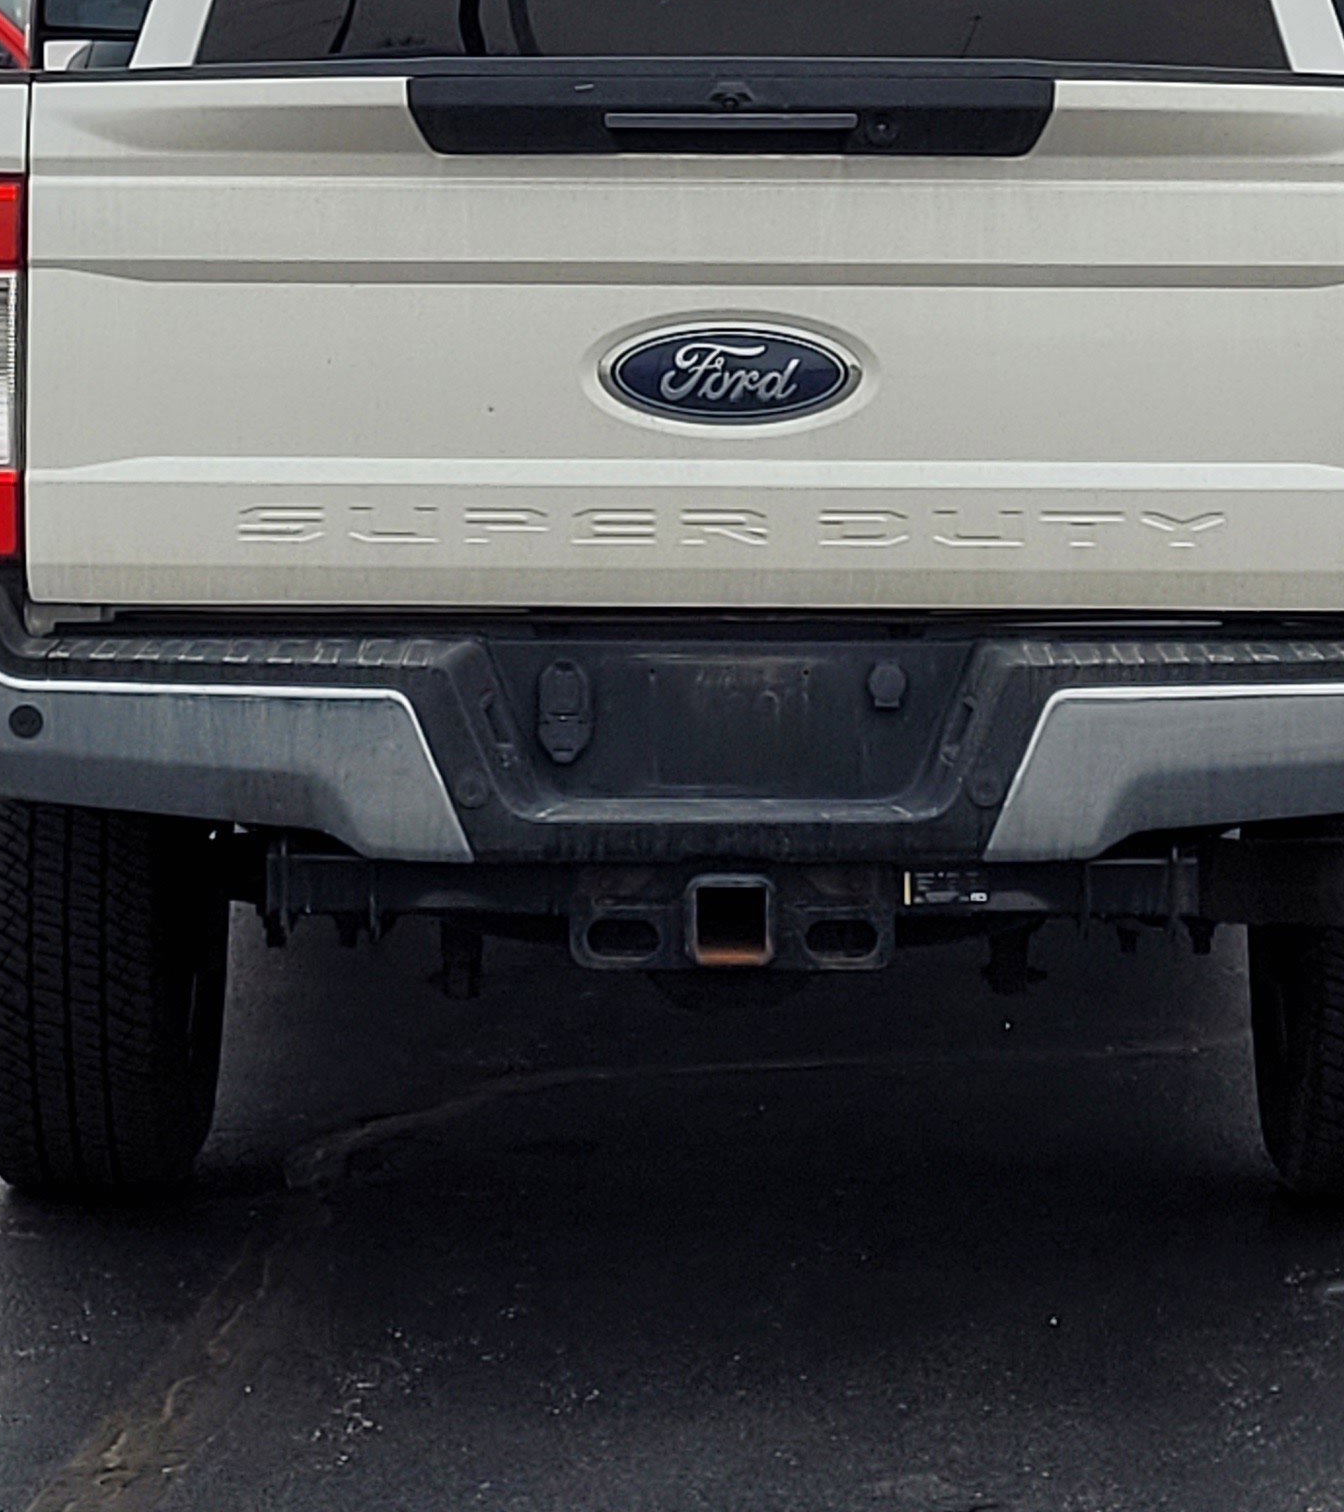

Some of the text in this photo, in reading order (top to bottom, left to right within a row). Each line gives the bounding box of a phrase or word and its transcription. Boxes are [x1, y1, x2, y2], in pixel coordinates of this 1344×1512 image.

[660, 342, 801, 402] Ford
[237, 506, 1226, 548] SUPER DUTY
